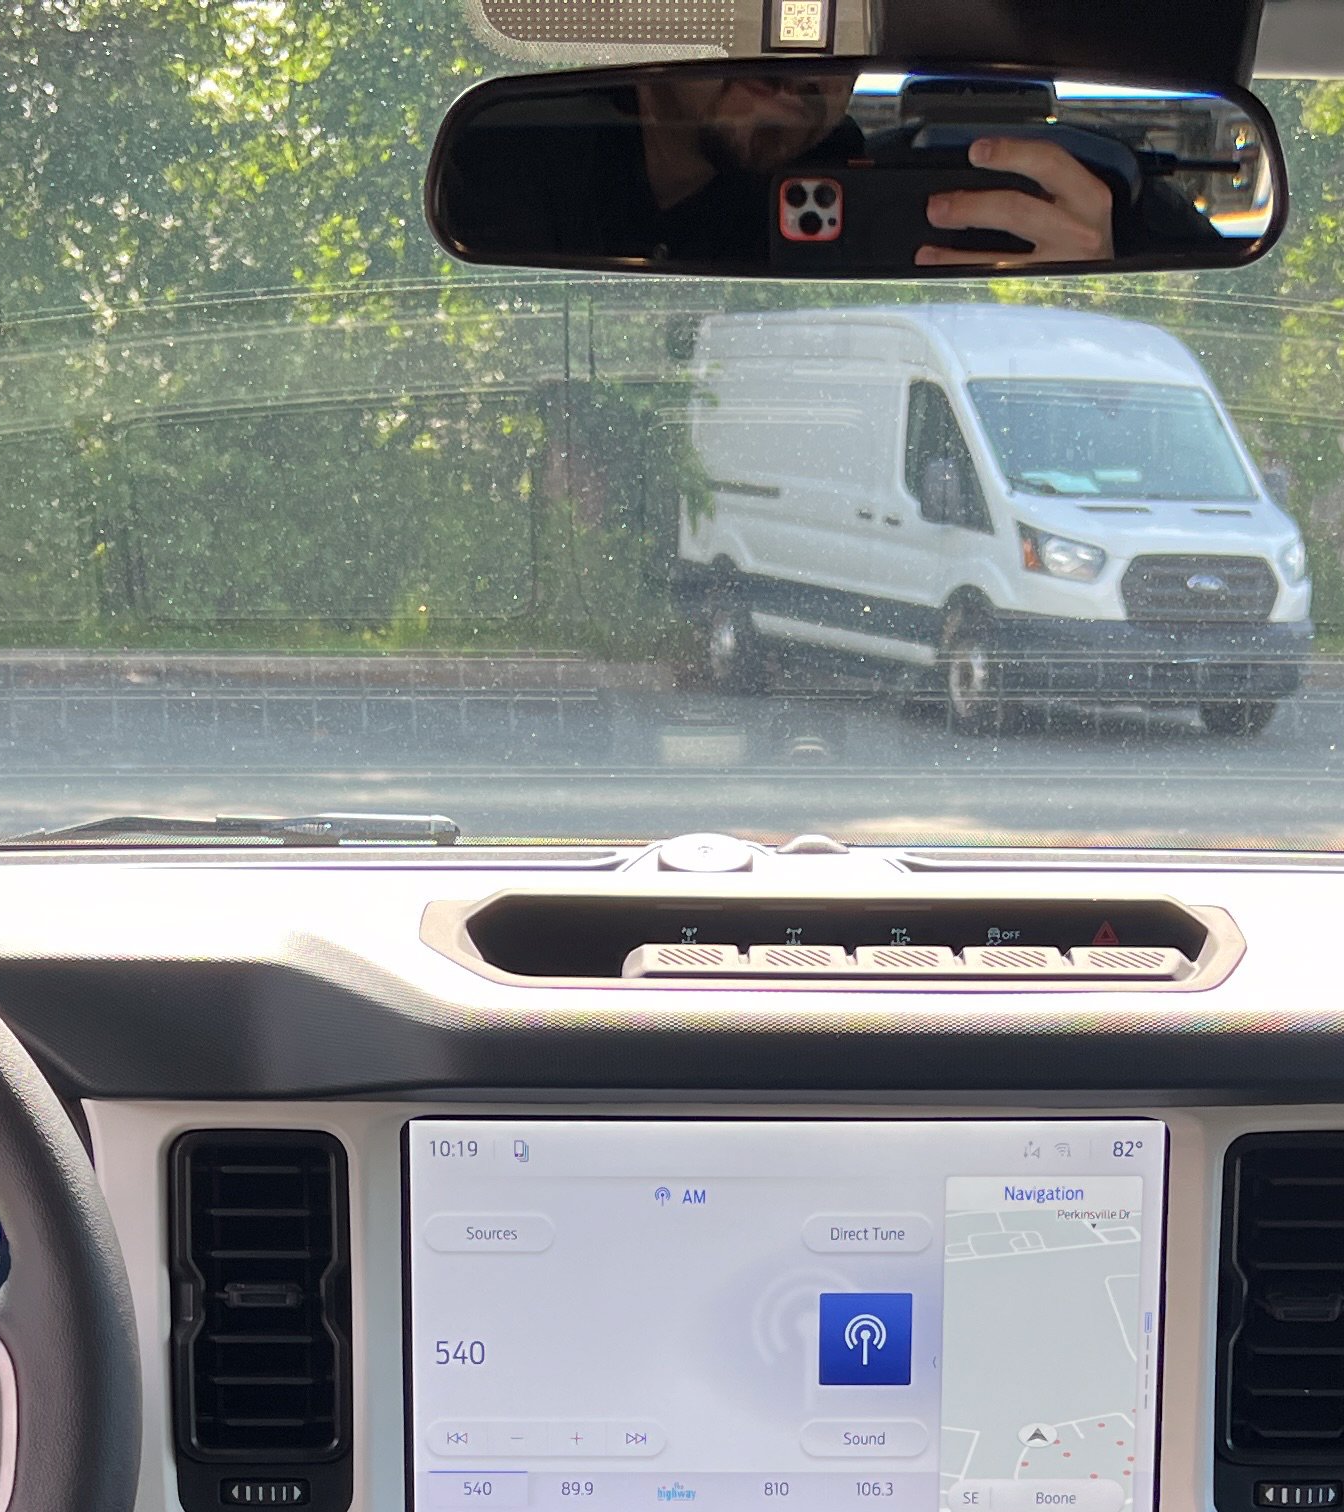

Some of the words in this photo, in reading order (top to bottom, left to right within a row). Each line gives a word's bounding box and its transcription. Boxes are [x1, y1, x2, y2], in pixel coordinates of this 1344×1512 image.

[1002, 930, 1021, 940] OFF
[428, 1140, 478, 1158] 10:19
[1112, 1140, 1144, 1158] 82°
[682, 1189, 707, 1205] AM
[1003, 1184, 1085, 1204] Navigation
[1057, 1209, 1116, 1220] Perkinsville
[1118, 1209, 1131, 1220] Dr
[465, 1226, 518, 1241] Sources
[829, 1226, 866, 1242] Direct
[870, 1226, 906, 1242] Tune
[434, 1341, 487, 1367] 540
[843, 1431, 886, 1447] Sound
[462, 1481, 493, 1497] 540
[560, 1481, 595, 1497] 89.9
[657, 1487, 697, 1501] highway
[763, 1481, 790, 1497] 810
[855, 1481, 894, 1497] 106.3
[962, 1491, 980, 1506] SE
[1034, 1490, 1077, 1506] Boone
